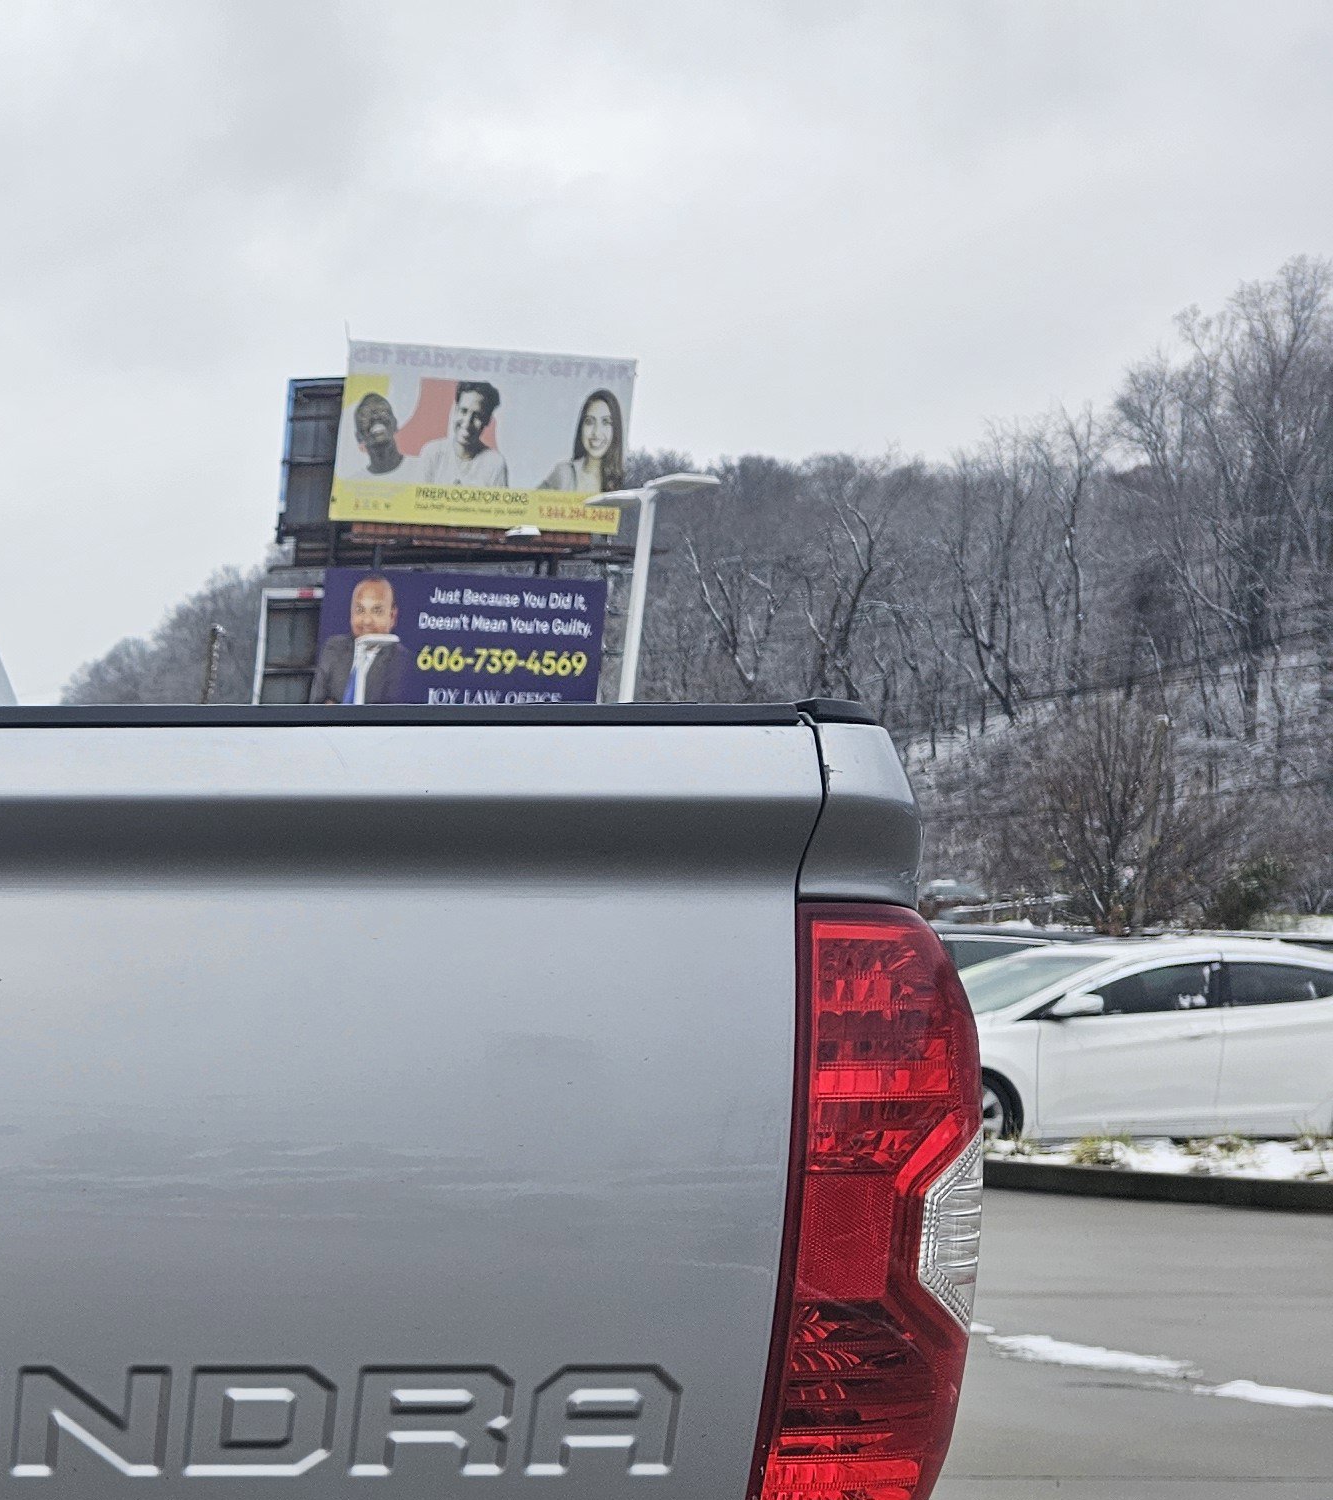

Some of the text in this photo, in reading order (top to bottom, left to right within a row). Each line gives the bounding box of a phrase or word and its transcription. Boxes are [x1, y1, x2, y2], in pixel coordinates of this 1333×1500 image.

[430, 587, 461, 605] Just
[463, 588, 521, 608] Because
[522, 591, 547, 609] You
[548, 592, 572, 610] Did
[418, 612, 593, 639] Doesn't Mean You're Guilty.
[416, 645, 588, 677] 606-739-4569
[462, 689, 503, 704] LAW
